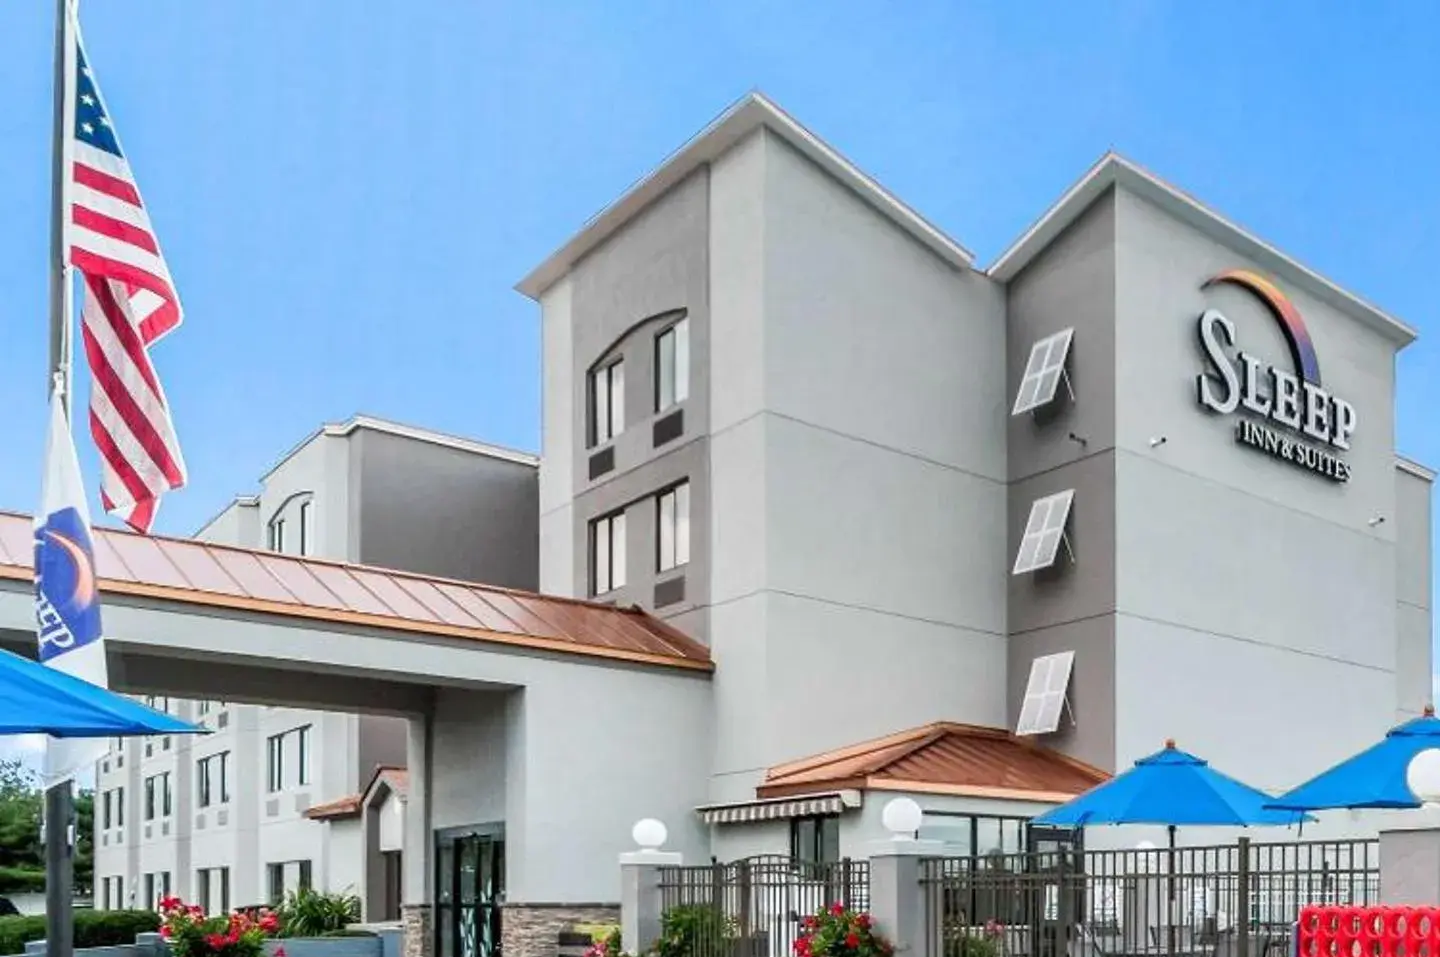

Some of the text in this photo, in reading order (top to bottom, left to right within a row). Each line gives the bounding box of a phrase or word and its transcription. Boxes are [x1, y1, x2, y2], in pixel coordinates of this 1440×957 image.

[1199, 309, 1356, 450] SLEEP
[1242, 420, 1352, 482] INN & SUITES
